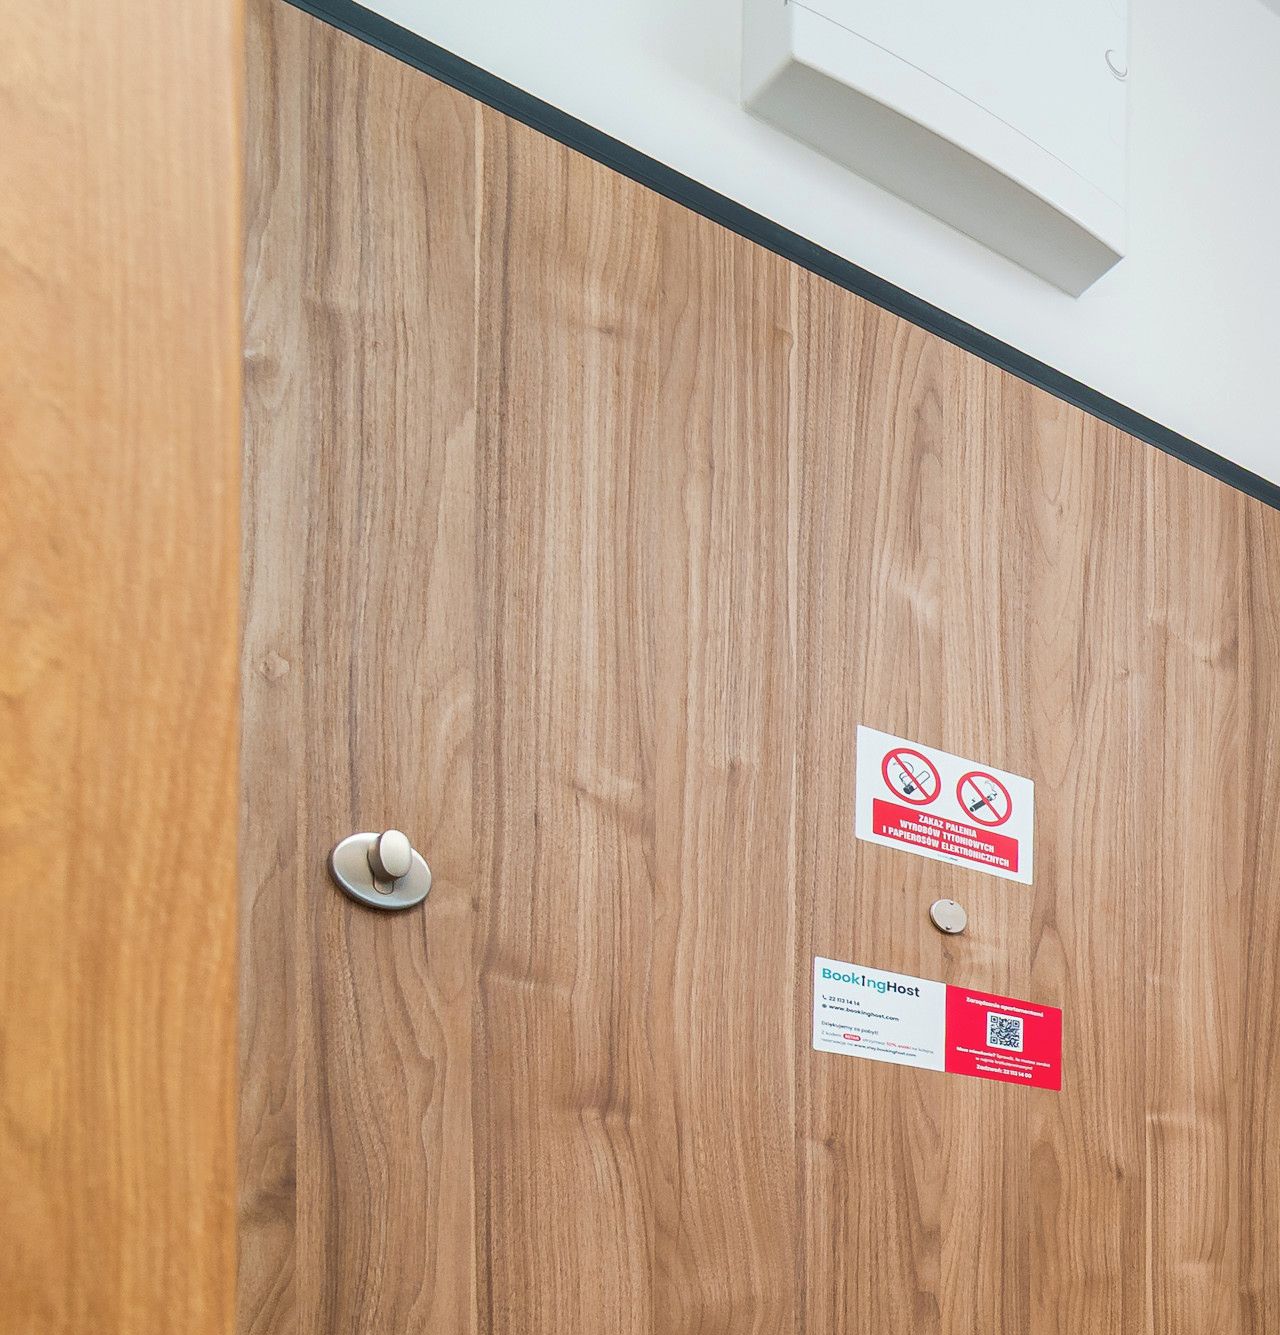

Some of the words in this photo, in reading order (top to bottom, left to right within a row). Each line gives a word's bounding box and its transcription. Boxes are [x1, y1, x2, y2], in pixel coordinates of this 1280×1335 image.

[900, 819, 940, 838] WYROBÓW
[942, 831, 995, 853] TYTONIOWYCH
[918, 815, 944, 829] ZAKAZ
[945, 822, 977, 838] PALENIA
[888, 826, 939, 848] PAPIEROSÓW
[941, 843, 1010, 867] ELEKTRONICZNYCH
